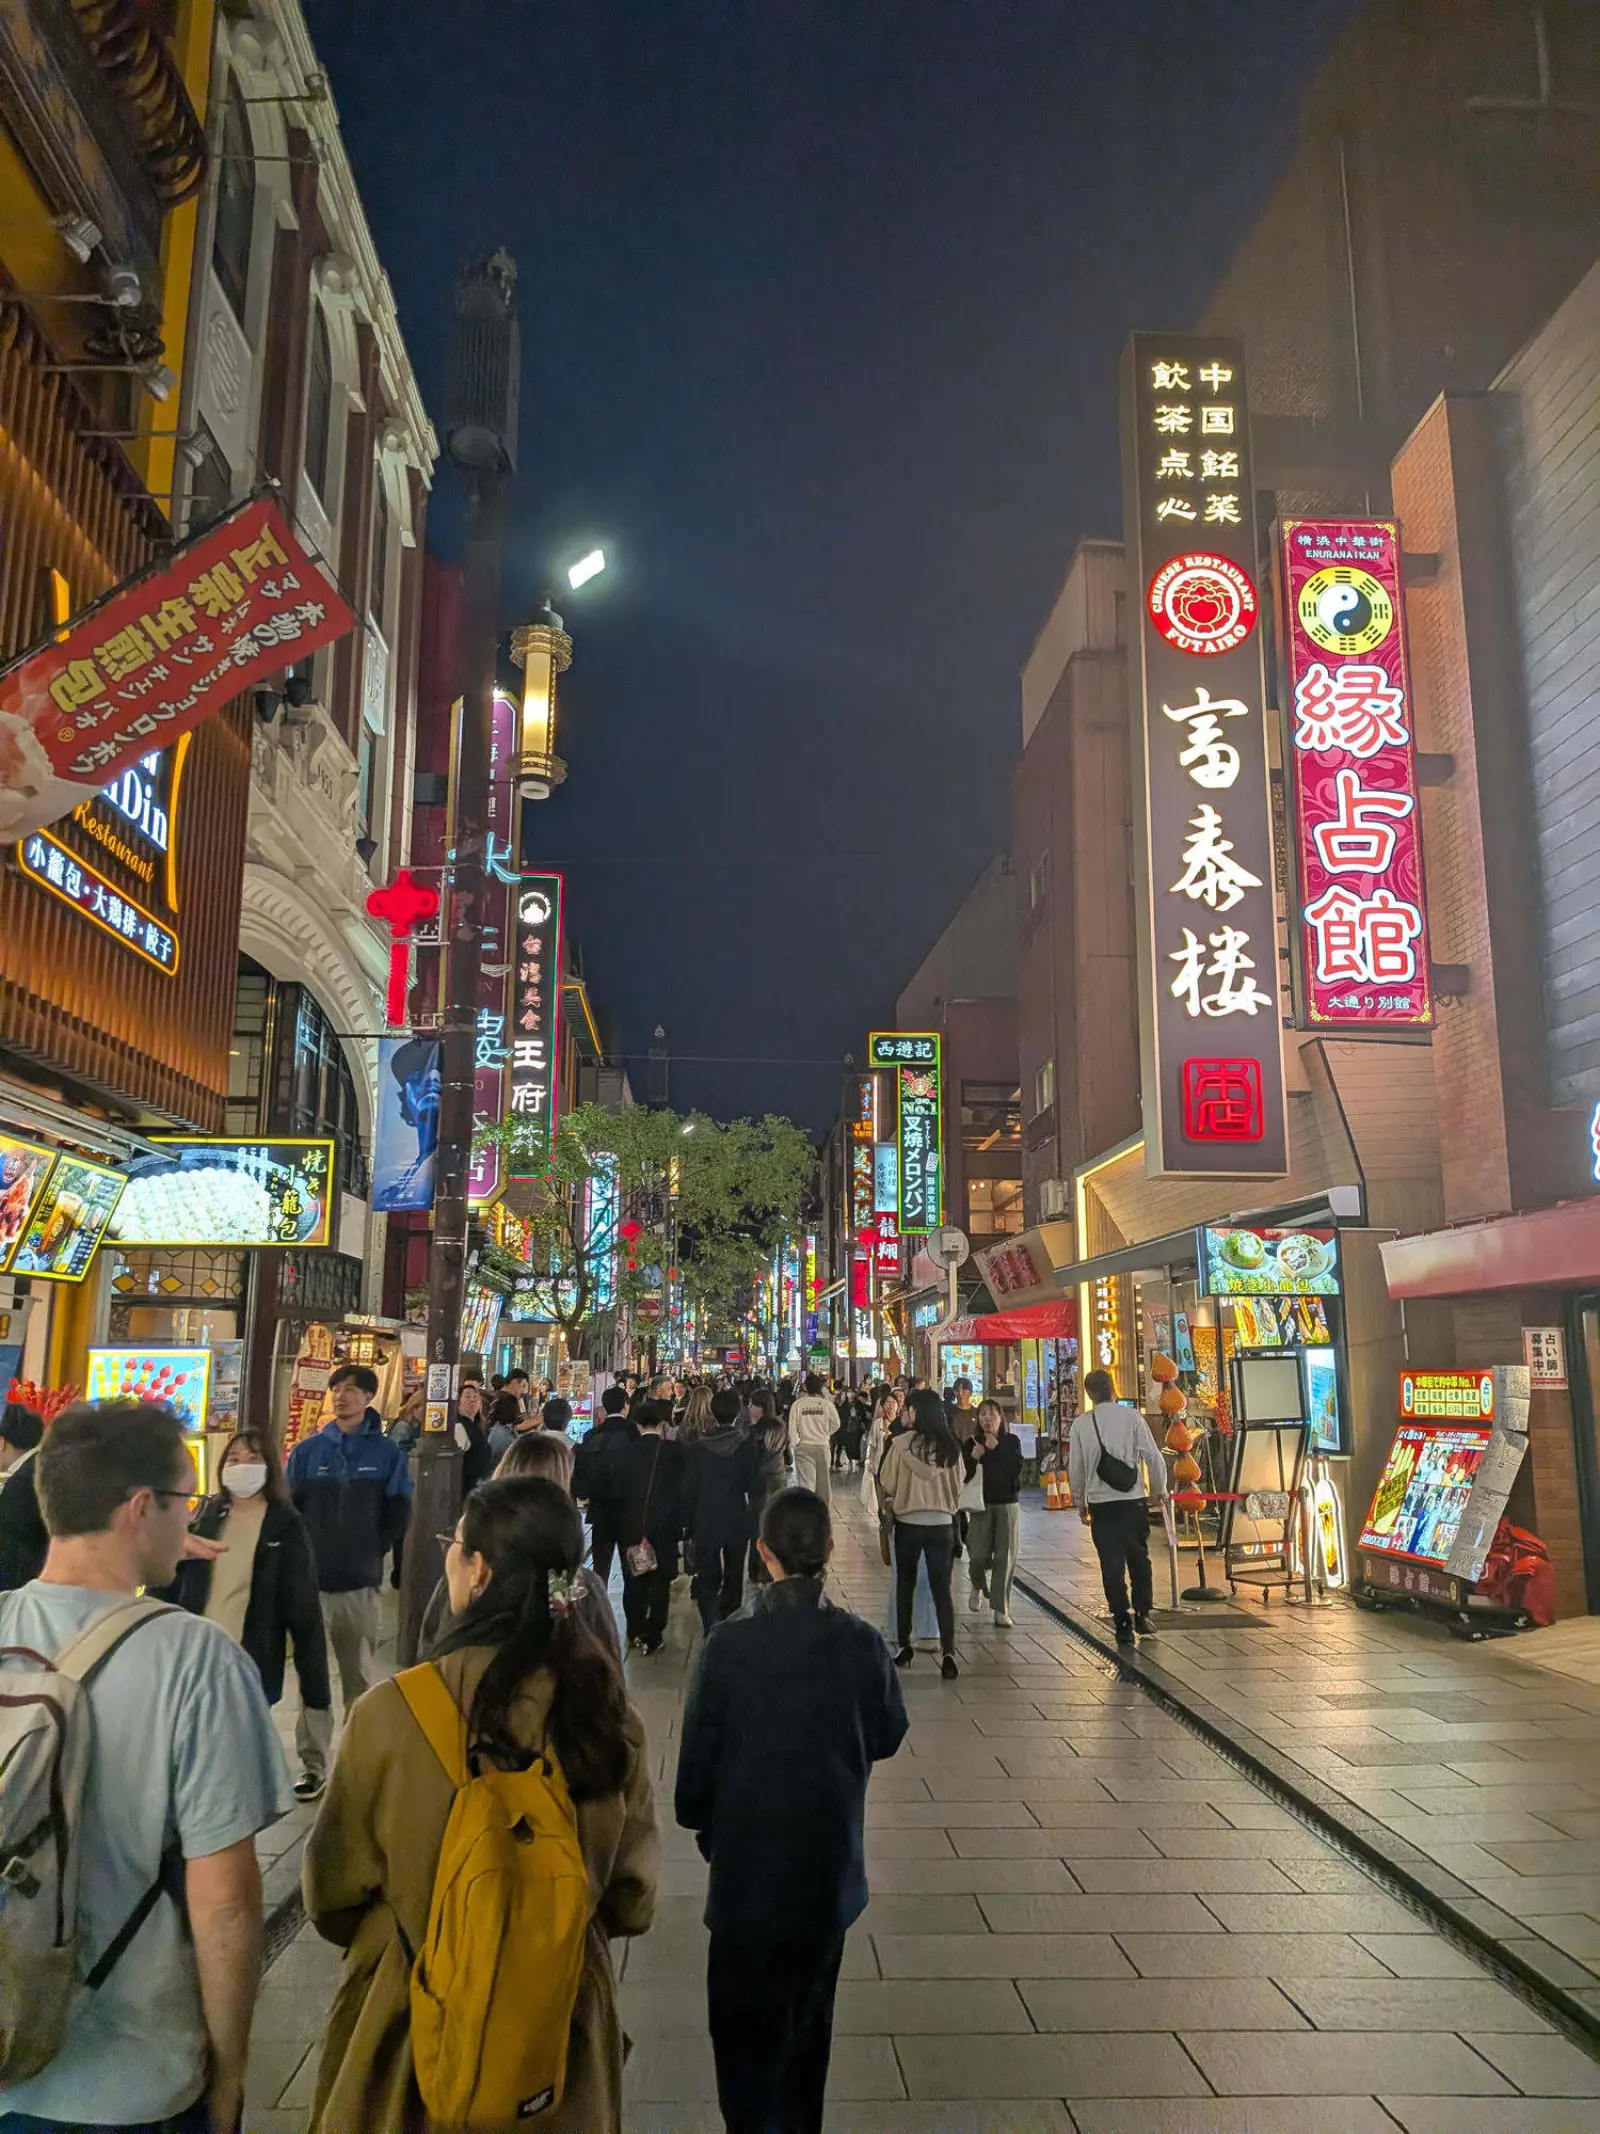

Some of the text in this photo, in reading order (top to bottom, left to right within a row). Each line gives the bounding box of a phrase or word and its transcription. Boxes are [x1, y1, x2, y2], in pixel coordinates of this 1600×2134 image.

[1152, 362, 1198, 523] 飲茶点心
[1199, 362, 1242, 525] 中国銘菜
[1297, 535, 1384, 547] 横浜中華街
[1306, 549, 1379, 560] ENURANAIKAN
[1152, 556, 1254, 613] CHINESE RESTAURANT
[48, 524, 289, 713] 正宗生煎包
[1165, 624, 1247, 653] FUTAIRO
[73, 800, 154, 884] Restaurant
[1294, 664, 1422, 985] 縁占館
[1328, 996, 1411, 1011] 大通り別館
[877, 1041, 933, 1059] 西遊記
[901, 1101, 938, 1116] No.1
[904, 1116, 923, 1219] 叉焼メロンパン
[877, 1216, 899, 1260] 龍翔
[1545, 1333, 1558, 1371] 占い師
